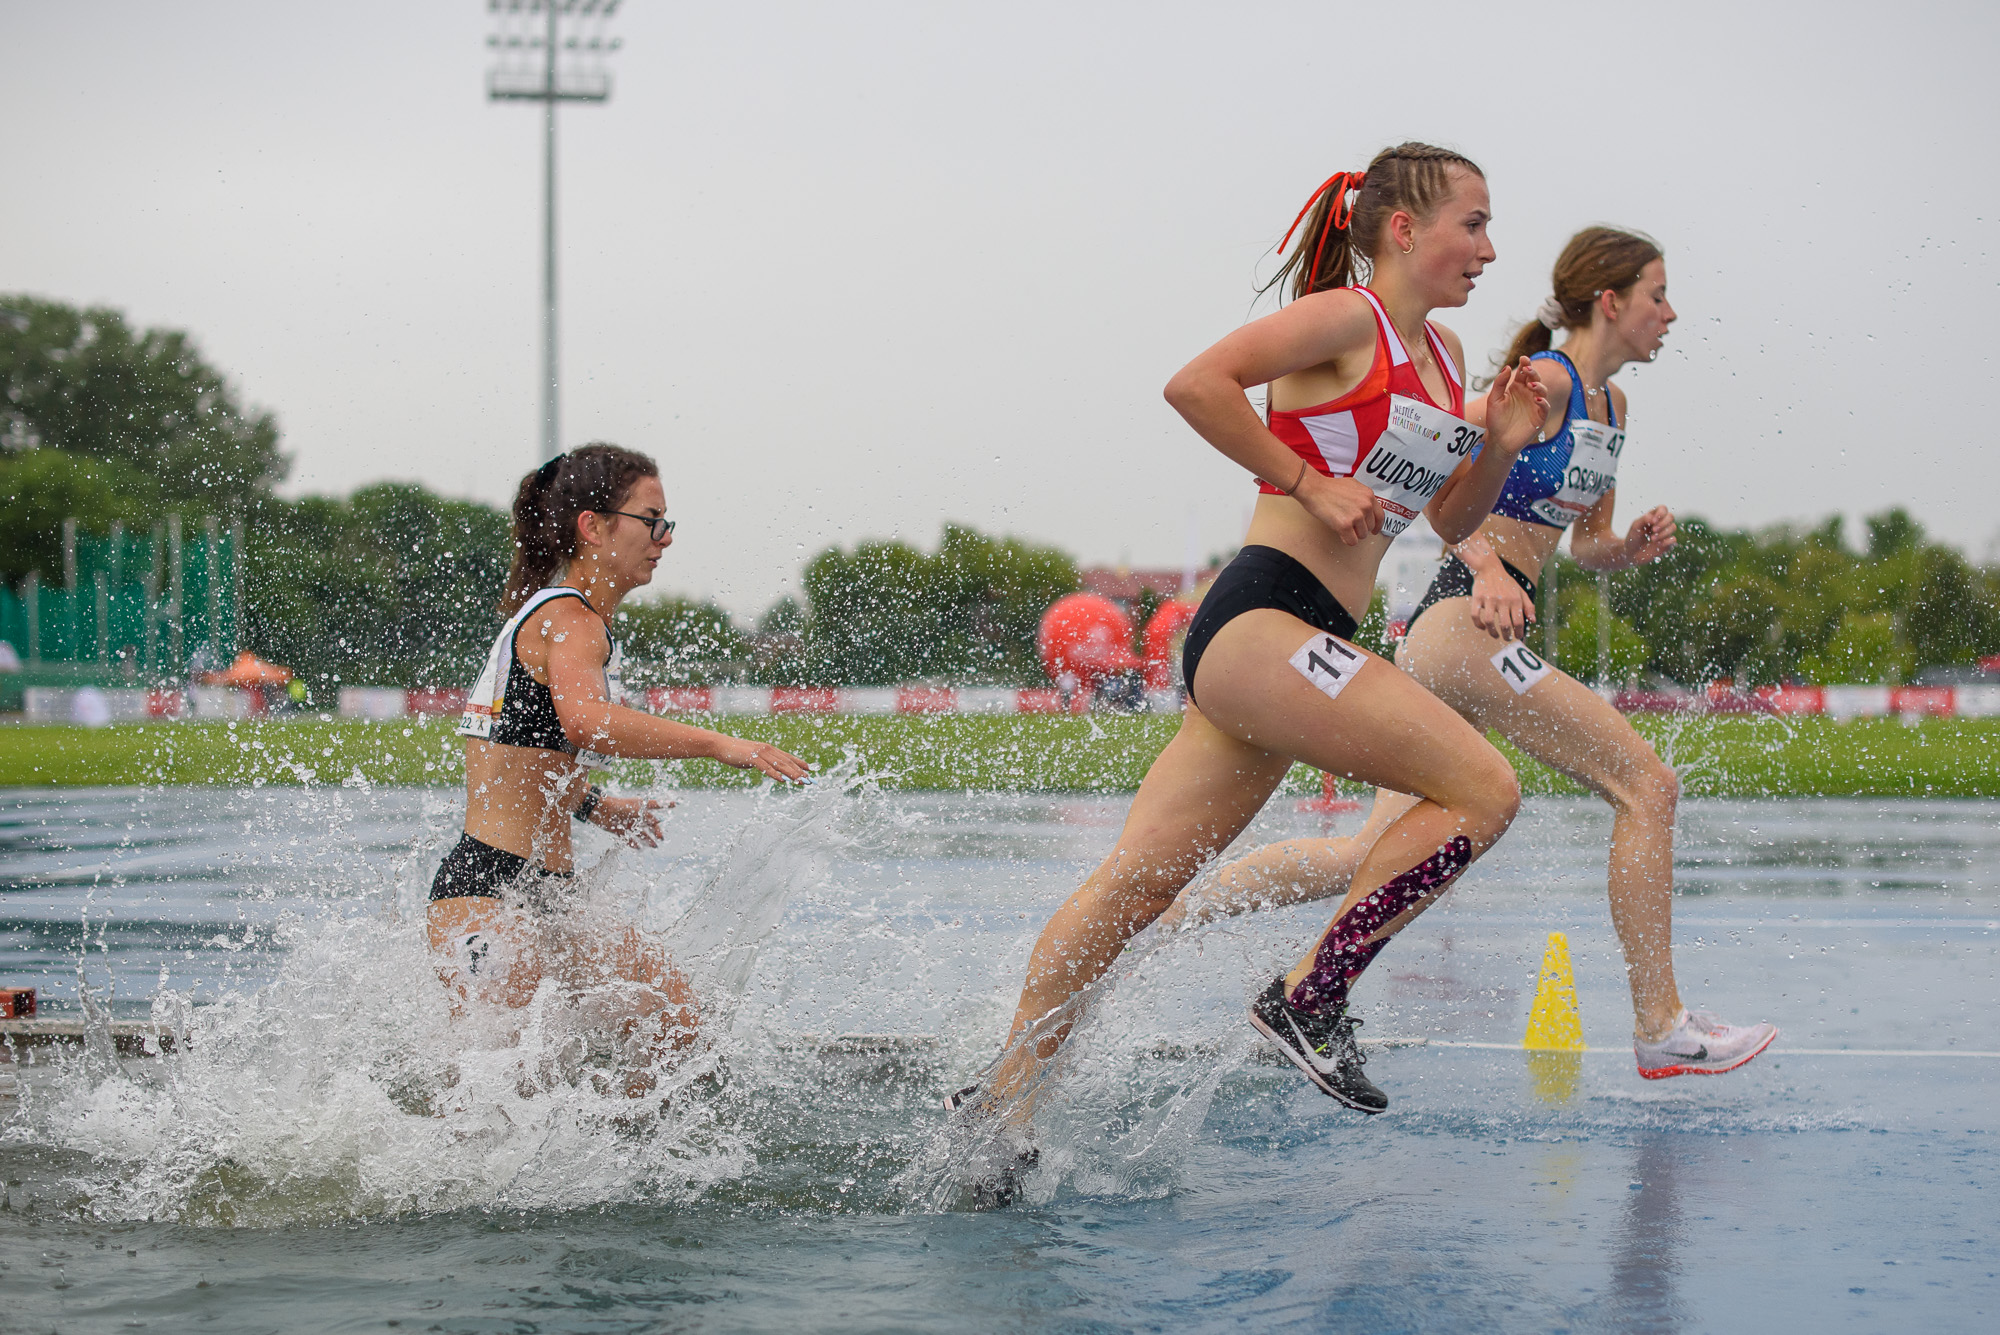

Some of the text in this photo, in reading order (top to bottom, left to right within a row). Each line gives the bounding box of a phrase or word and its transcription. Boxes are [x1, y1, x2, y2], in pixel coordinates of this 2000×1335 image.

[1392, 415, 1434, 439] HEALTHIER KIDS
[1413, 413, 1421, 422] for
[1308, 637, 1357, 680] 11
[1501, 647, 1543, 683] 10
